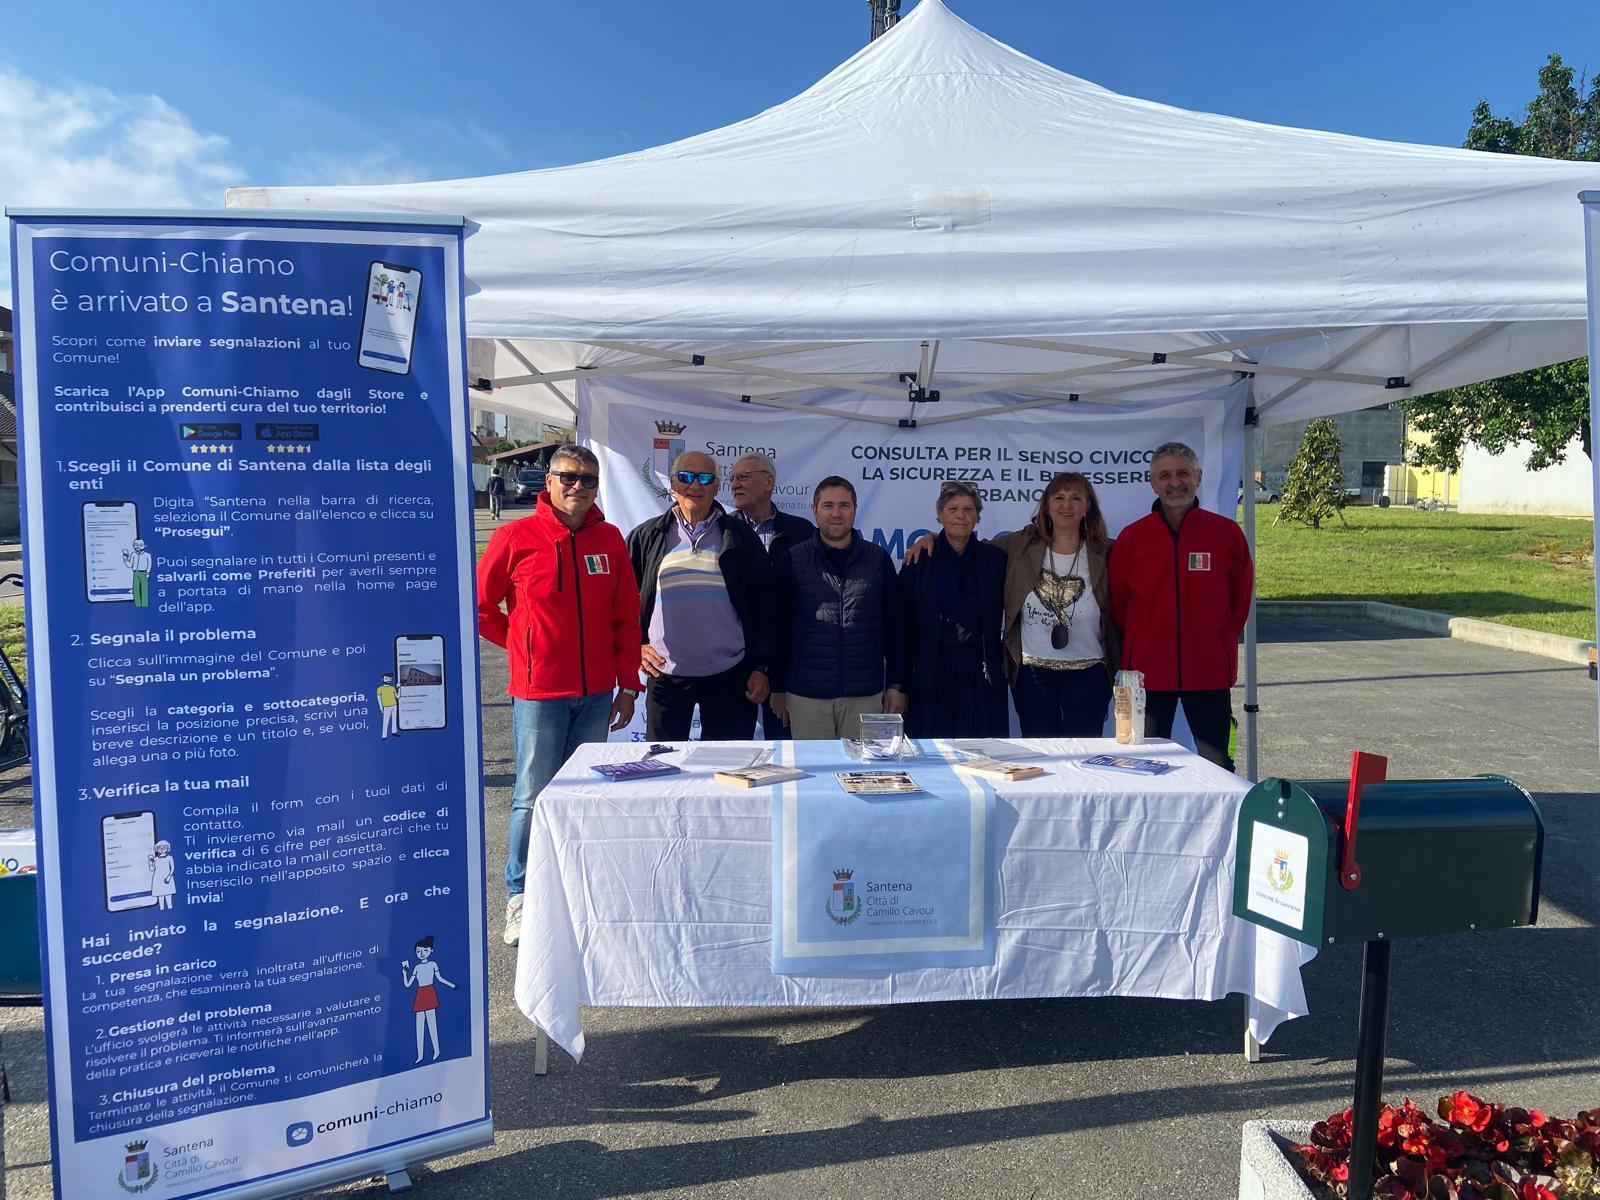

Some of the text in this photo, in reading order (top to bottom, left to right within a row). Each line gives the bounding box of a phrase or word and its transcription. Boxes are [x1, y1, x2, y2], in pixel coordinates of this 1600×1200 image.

[50, 251, 294, 275] Comuni-Chiamo
[52, 289, 352, 316] è arrivato a Santena!
[52, 336, 97, 348] Scopri
[154, 336, 201, 346] inviare
[210, 337, 300, 349] segnalazioni
[309, 339, 319, 349] al
[328, 341, 350, 350] tuo
[53, 352, 119, 363] Comune!
[55, 386, 428, 400] Scarica l'App Comuni-Chiamo dagli Store e
[55, 401, 386, 414] contribuisci a prenderti cura del tuo territorio!
[851, 446, 949, 461] CONSULTA
[954, 448, 992, 461] PER
[997, 448, 1013, 461] IL
[1018, 450, 1083, 465] SENSO
[128, 460, 136, 471] il
[144, 460, 211, 471] Comune
[218, 459, 232, 470] di
[239, 460, 306, 470] Santena
[313, 460, 350, 470] dalla
[357, 459, 388, 470] lista
[395, 460, 431, 473] degli
[862, 467, 884, 480] LA
[890, 468, 994, 482] SICUREZZA
[1001, 468, 1011, 482] E
[1017, 468, 1034, 482] IL
[69, 477, 102, 489] enti
[772, 485, 810, 495] avour
[154, 495, 433, 509] Digita “Santena nella barra di ricerca,
[978, 488, 1044, 502] RBANO
[154, 512, 215, 522] seleziona
[220, 511, 226, 521] il
[231, 511, 290, 521] Comune
[295, 510, 365, 520] dall'elenco
[381, 509, 416, 518] clicca
[155, 526, 235, 538] “Prosegui”.
[157, 557, 187, 566] Puoi
[191, 556, 256, 568] segnalare
[262, 555, 273, 564] in
[278, 554, 306, 564] tutti
[310, 554, 313, 562] i
[318, 552, 369, 562] Comuni
[374, 551, 424, 563] presenti
[157, 566, 436, 582] salvarli come Preferiti per averli sempre
[71, 628, 256, 646] 2. Segnala il problema
[88, 658, 131, 668] Clicca
[138, 653, 235, 665] sull'immagine
[241, 651, 261, 661] del
[268, 649, 326, 660] Comune
[346, 644, 365, 656] poi
[89, 678, 105, 686] su
[110, 672, 175, 685] “Segnala
[202, 668, 278, 682] problema”.
[91, 708, 134, 723] Scegli
[146, 706, 156, 716] la
[168, 702, 234, 718] categoria
[263, 692, 368, 710] sottocategoria,
[166, 780, 178, 791] la
[184, 780, 210, 790] tua
[216, 776, 249, 788] mail
[867, 882, 912, 892] Santena
[867, 896, 899, 906] Città di
[1281, 901, 1300, 912] SANTENA
[82, 886, 450, 948] Hai inviato la segnalazione. E ora che
[867, 906, 934, 916] Camillo Cavour
[82, 943, 162, 966] succede?
[82, 945, 378, 1001] La tua segnalazione verrà inoltrata all'ufficio di
[111, 970, 151, 983] Presa
[156, 964, 169, 974] in
[174, 959, 216, 971] carico
[82, 993, 163, 1013] competenza,
[166, 989, 187, 998] che
[191, 980, 252, 995] esaminerà
[268, 977, 286, 986] tua
[287, 959, 365, 983] segnalazione.
[179, 1010, 200, 1022] del
[205, 1003, 273, 1023] problema
[182, 1074, 204, 1088] del
[208, 1065, 276, 1084] problema
[317, 1090, 443, 1134] comuni-chiamo
[164, 1138, 214, 1158] Santena
[164, 1155, 199, 1169] Città di
[164, 1165, 202, 1179] Camillo
[204, 1156, 240, 1170] Cavour
